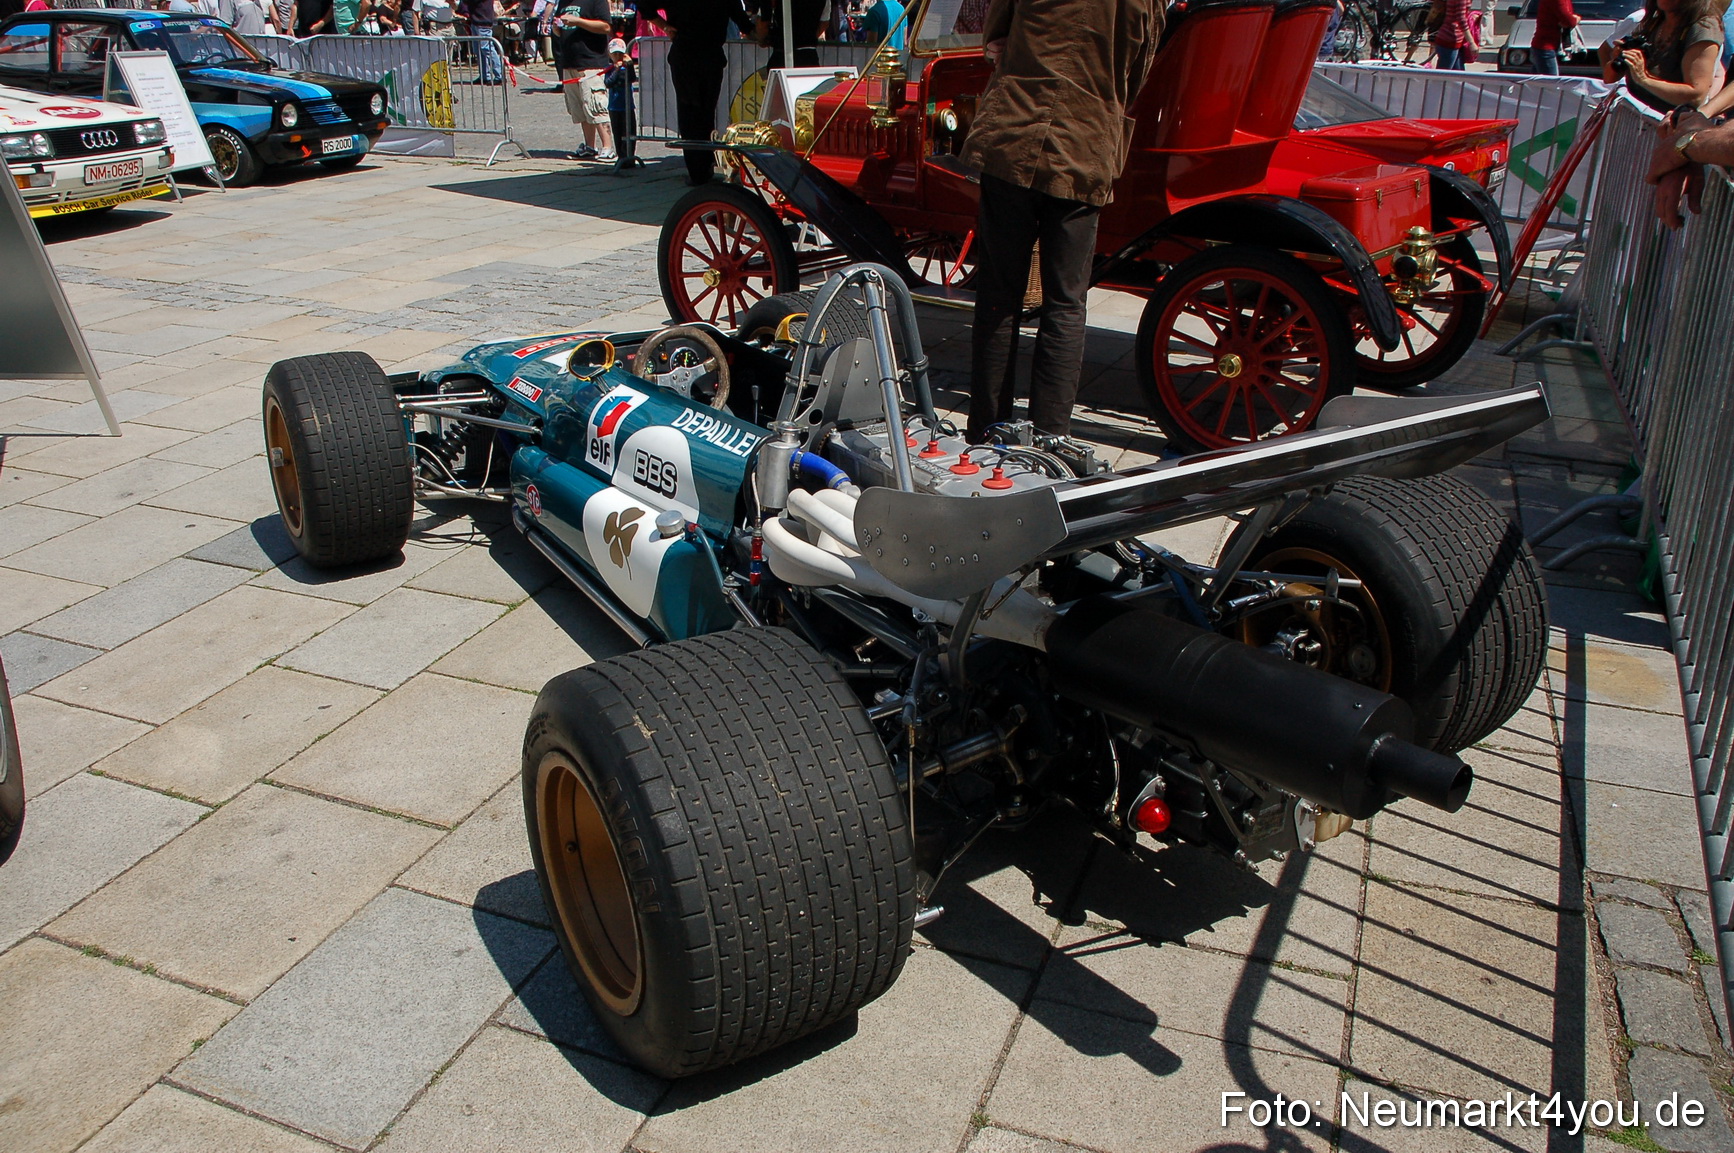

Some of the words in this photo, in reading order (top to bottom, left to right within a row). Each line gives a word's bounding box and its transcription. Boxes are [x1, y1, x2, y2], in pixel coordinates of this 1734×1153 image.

[323, 141, 334, 152] RS
[336, 138, 352, 150] 2000
[90, 161, 139, 180] NM-06295
[52, 203, 81, 214] BOSCH
[83, 200, 99, 209] Car
[100, 194, 131, 206] Service
[590, 438, 611, 466] elf
[633, 448, 678, 500] BBS
[528, 489, 540, 509] STP
